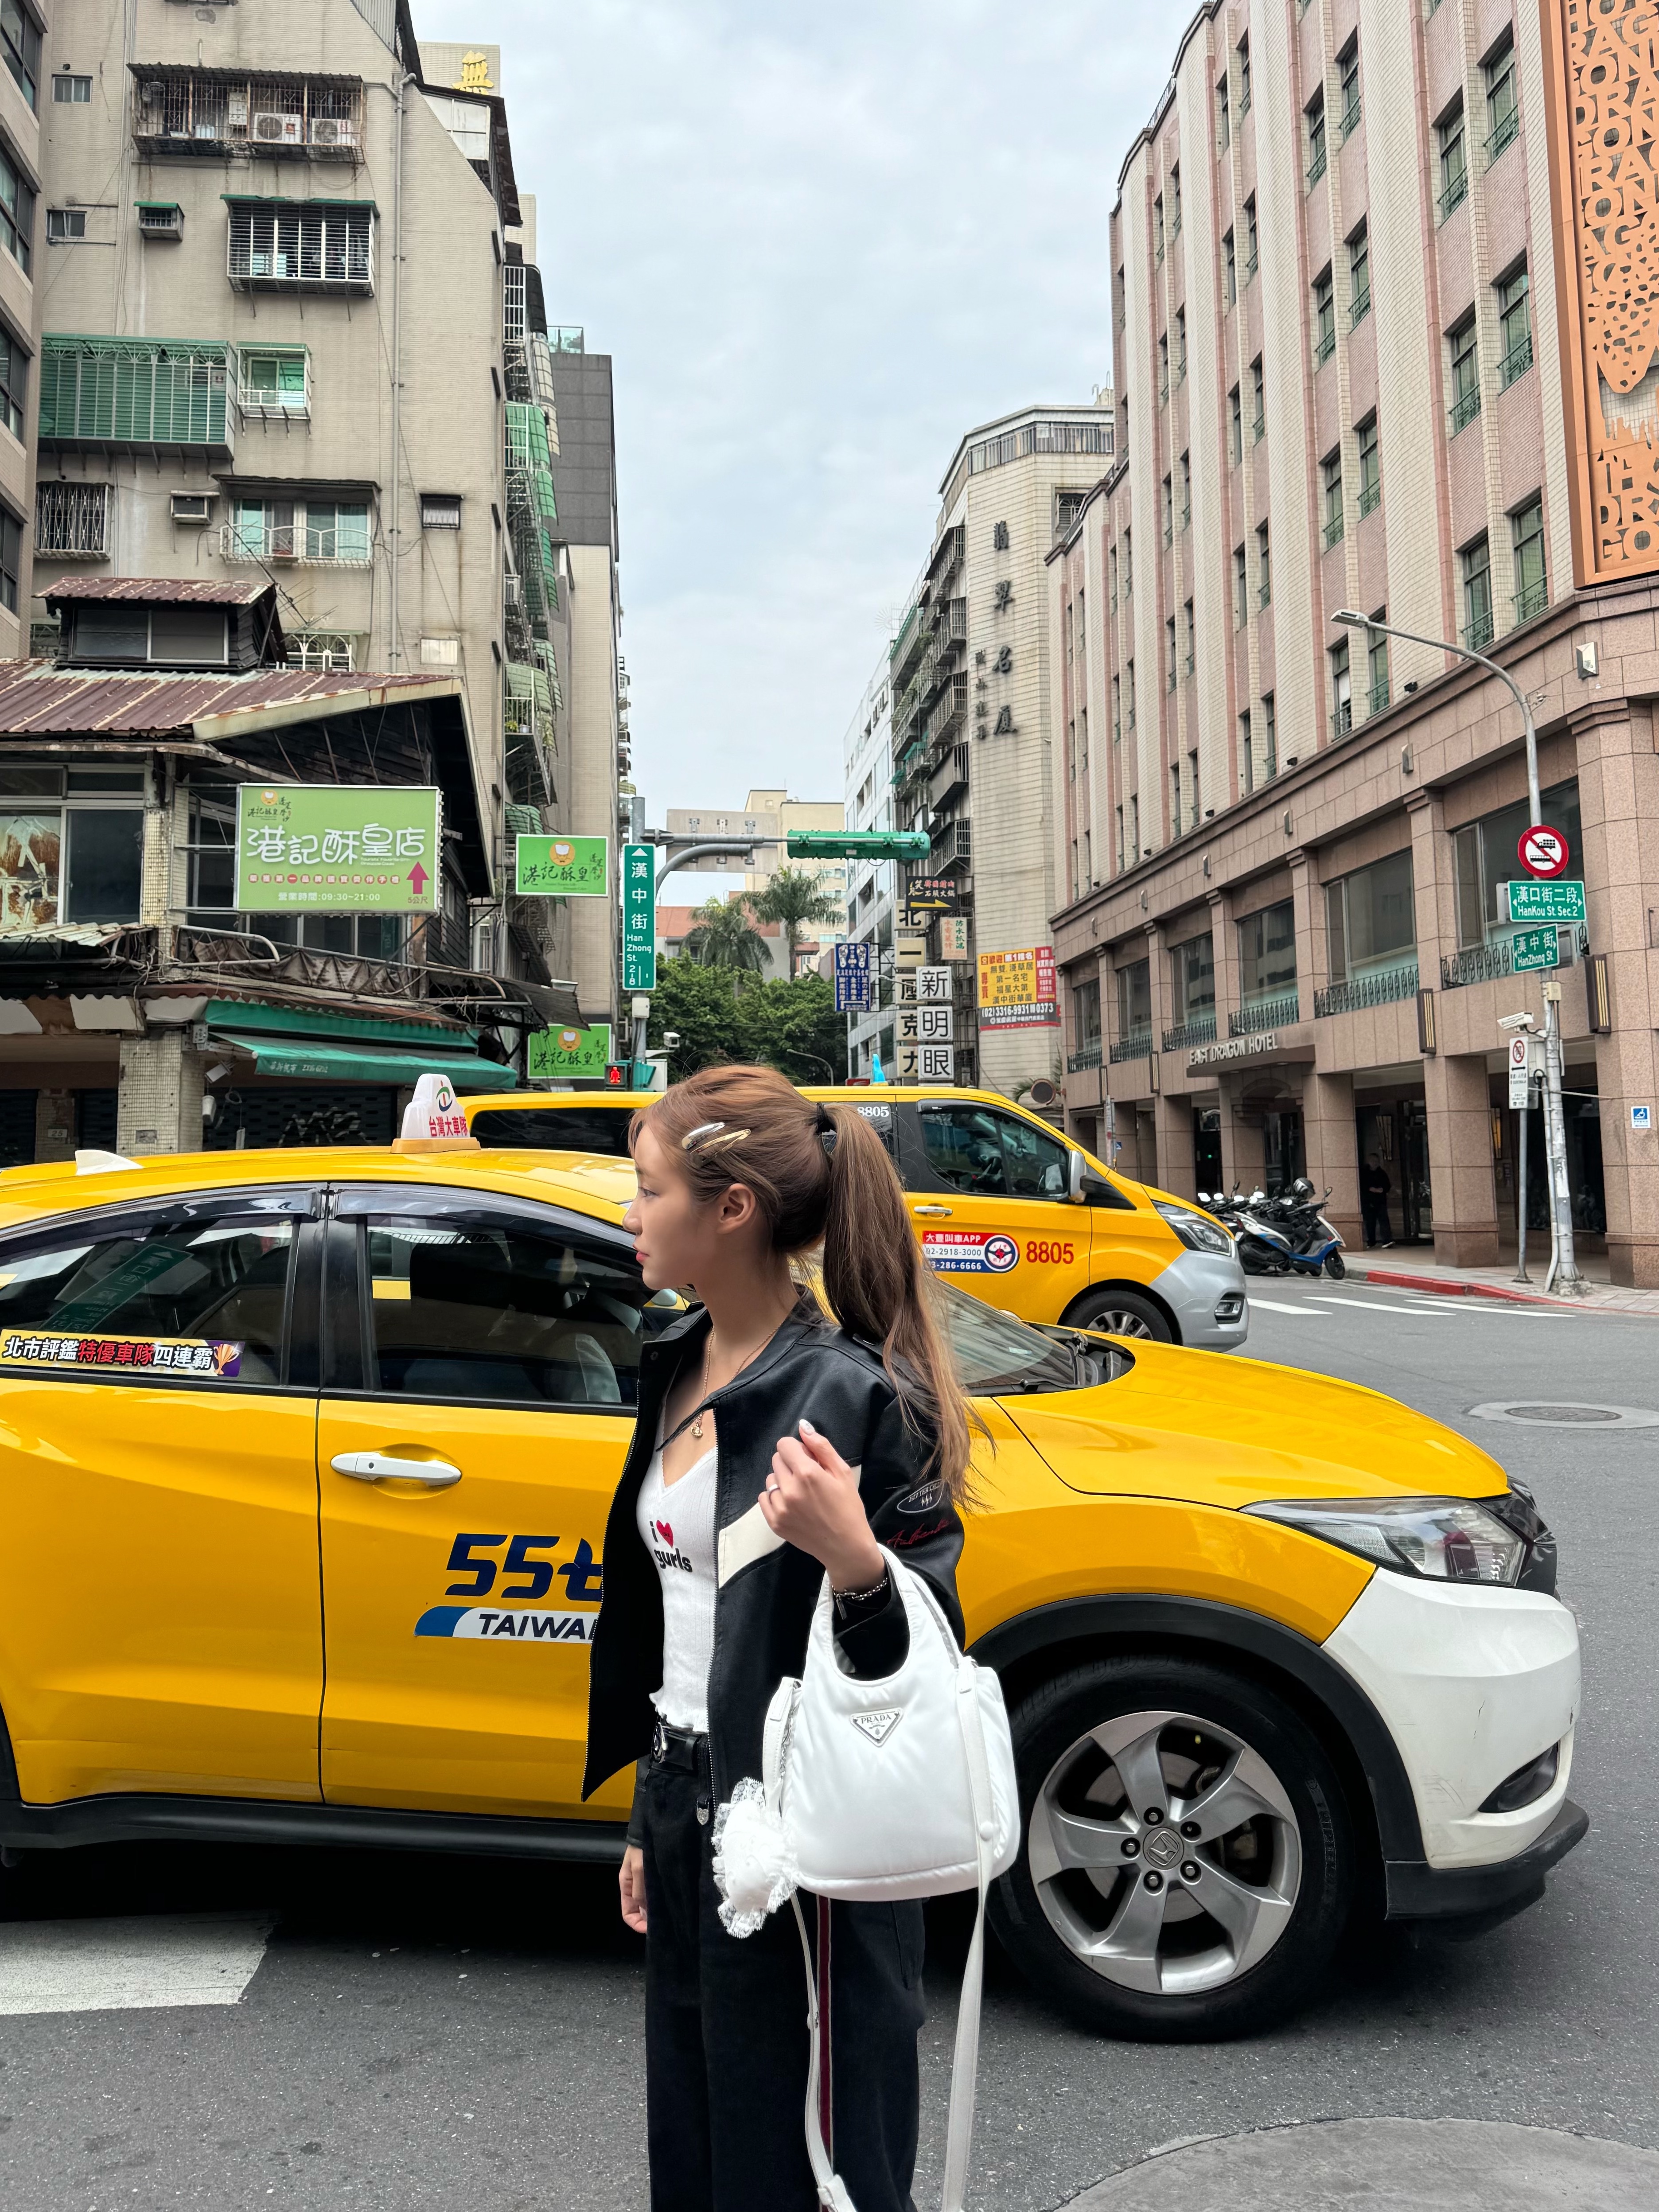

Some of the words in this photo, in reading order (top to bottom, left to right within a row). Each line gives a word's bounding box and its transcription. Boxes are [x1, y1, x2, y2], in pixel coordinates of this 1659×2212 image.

[246, 823, 426, 865] 港記酥皇店
[523, 861, 589, 886] 港記酥皇
[631, 862, 648, 930] 漢中街
[1516, 886, 1577, 903] 漢口街二段
[1518, 907, 1545, 916] HanKou
[627, 944, 652, 954] Zhong
[1516, 931, 1553, 954] 漢中街
[1518, 954, 1545, 967] HanZhong
[922, 970, 950, 1076] 新明眼
[1189, 1047, 1210, 1066] EAST
[1211, 1039, 1246, 1062] DRAGON
[1248, 1032, 1278, 1054] HOTEL
[857, 1106, 889, 1118] 8805
[429, 1115, 468, 1137] 台灣大車隊
[1026, 1241, 1074, 1265] 8805
[4, 1336, 213, 1370] 北市評鑑特優車隊四連霸
[650, 1521, 658, 1542] i
[654, 1548, 693, 1573] gurls
[861, 1714, 892, 1724] PRADA
